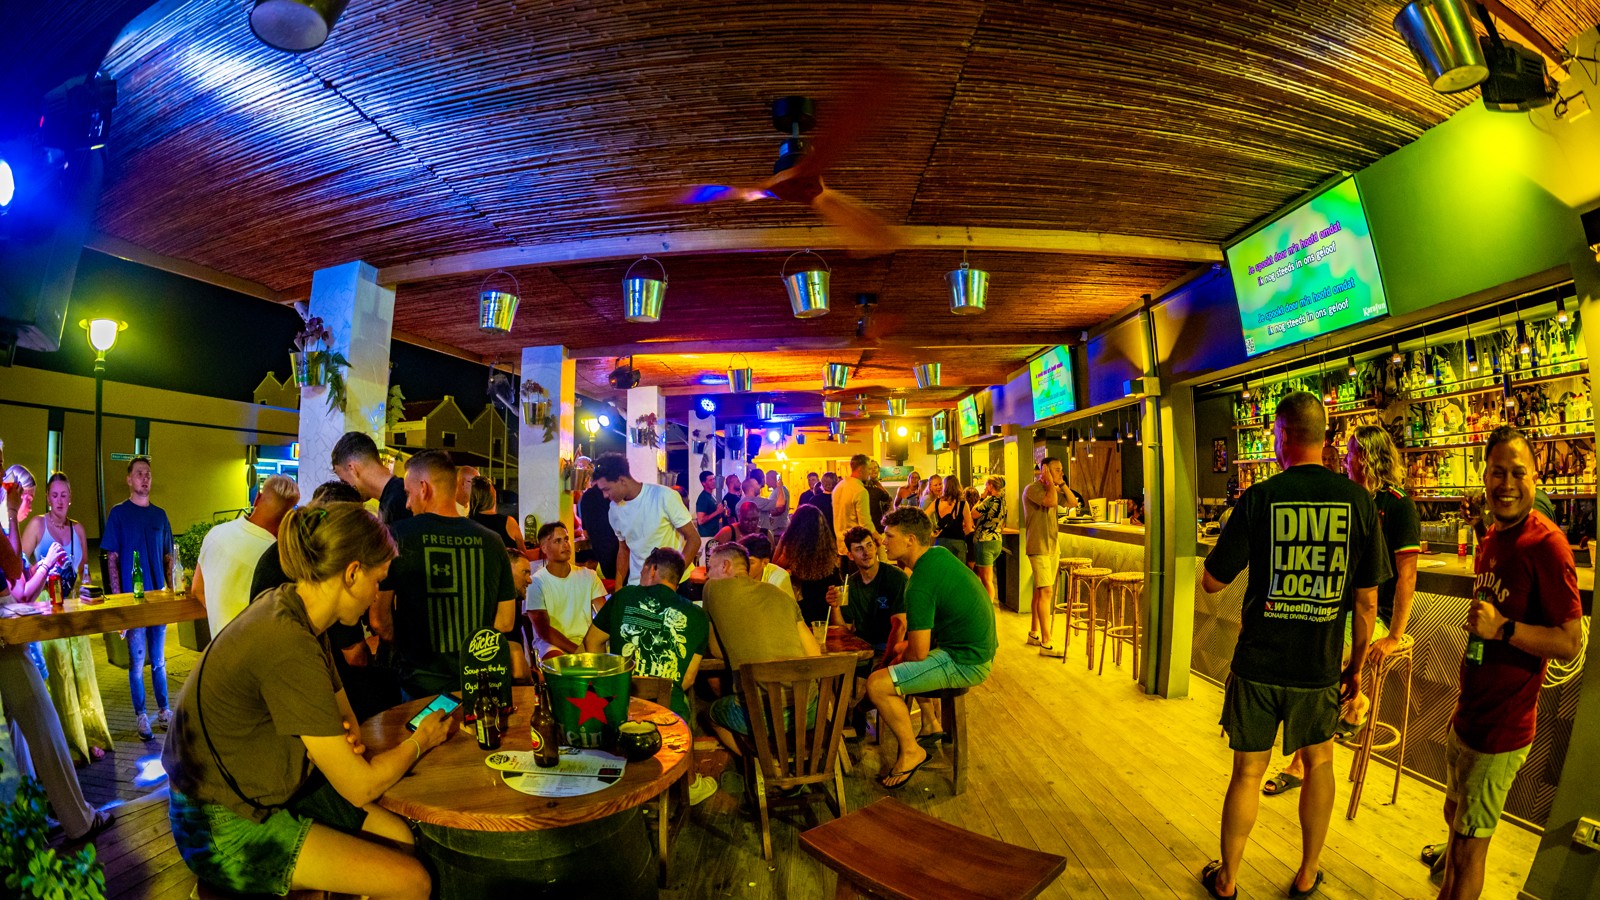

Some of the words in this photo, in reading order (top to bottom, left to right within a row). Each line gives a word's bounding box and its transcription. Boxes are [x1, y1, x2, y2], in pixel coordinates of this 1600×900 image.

[1248, 266, 1255, 275] Je
[1255, 255, 1274, 272] spookt
[1274, 252, 1287, 262] door
[1287, 243, 1300, 256] m'n
[1299, 231, 1319, 249] hoofd
[1319, 220, 1341, 239] omdat
[1264, 272, 1276, 283] nog
[1275, 262, 1295, 278] steeds
[1295, 259, 1303, 269] in
[1303, 253, 1315, 265] ons
[1315, 241, 1337, 262] geloof
[1258, 313, 1265, 323] Je
[1265, 305, 1285, 321] spookt
[1285, 301, 1298, 313] door
[1299, 295, 1312, 308] m'n
[1312, 286, 1332, 303] hoofd
[1332, 277, 1355, 295] omdat
[1274, 322, 1287, 333] nog
[1286, 314, 1306, 329] steeds
[1306, 311, 1314, 322] in
[1315, 307, 1327, 319] ons
[1328, 297, 1349, 318] geloof
[1275, 507, 1347, 542] DIVE
[422, 534, 483, 546] FREEDOM
[1274, 546, 1326, 571] LIKE
[1329, 546, 1347, 572] A
[1271, 573, 1343, 599] LOCAL!
[1263, 611, 1289, 620] BONAIRE
[1289, 613, 1308, 621] DIVING
[469, 631, 501, 653] BUCKET
[463, 665, 479, 676] Soup
[487, 664, 497, 672] the
